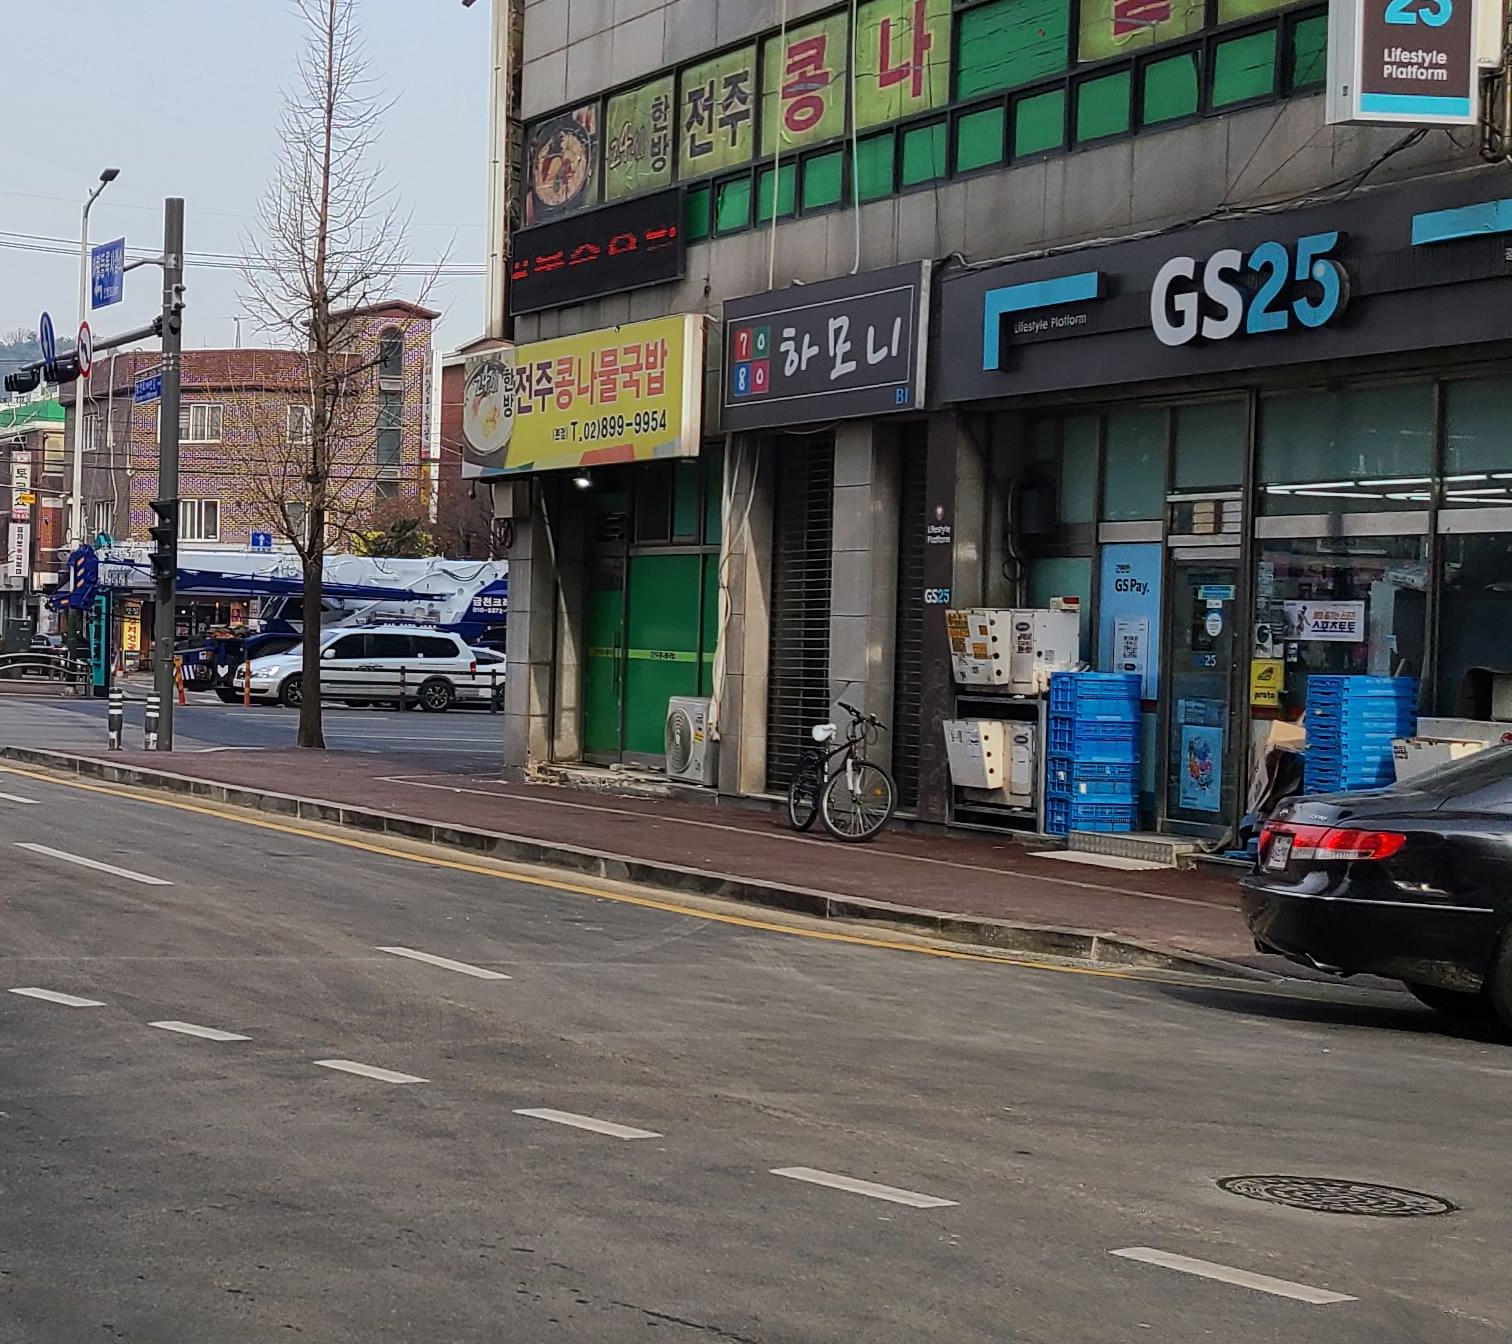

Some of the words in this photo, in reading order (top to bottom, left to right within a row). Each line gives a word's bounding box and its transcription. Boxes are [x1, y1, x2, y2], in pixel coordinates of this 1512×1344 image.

[1383, 46, 1448, 67] Lifestyle
[1383, 63, 1448, 82] Platform
[1150, 230, 1348, 347] GS25
[1013, 318, 1049, 335] Lifestyle
[1050, 313, 1088, 328] Platform
[779, 315, 902, 381] 하모니
[924, 588, 951, 604] GS25
